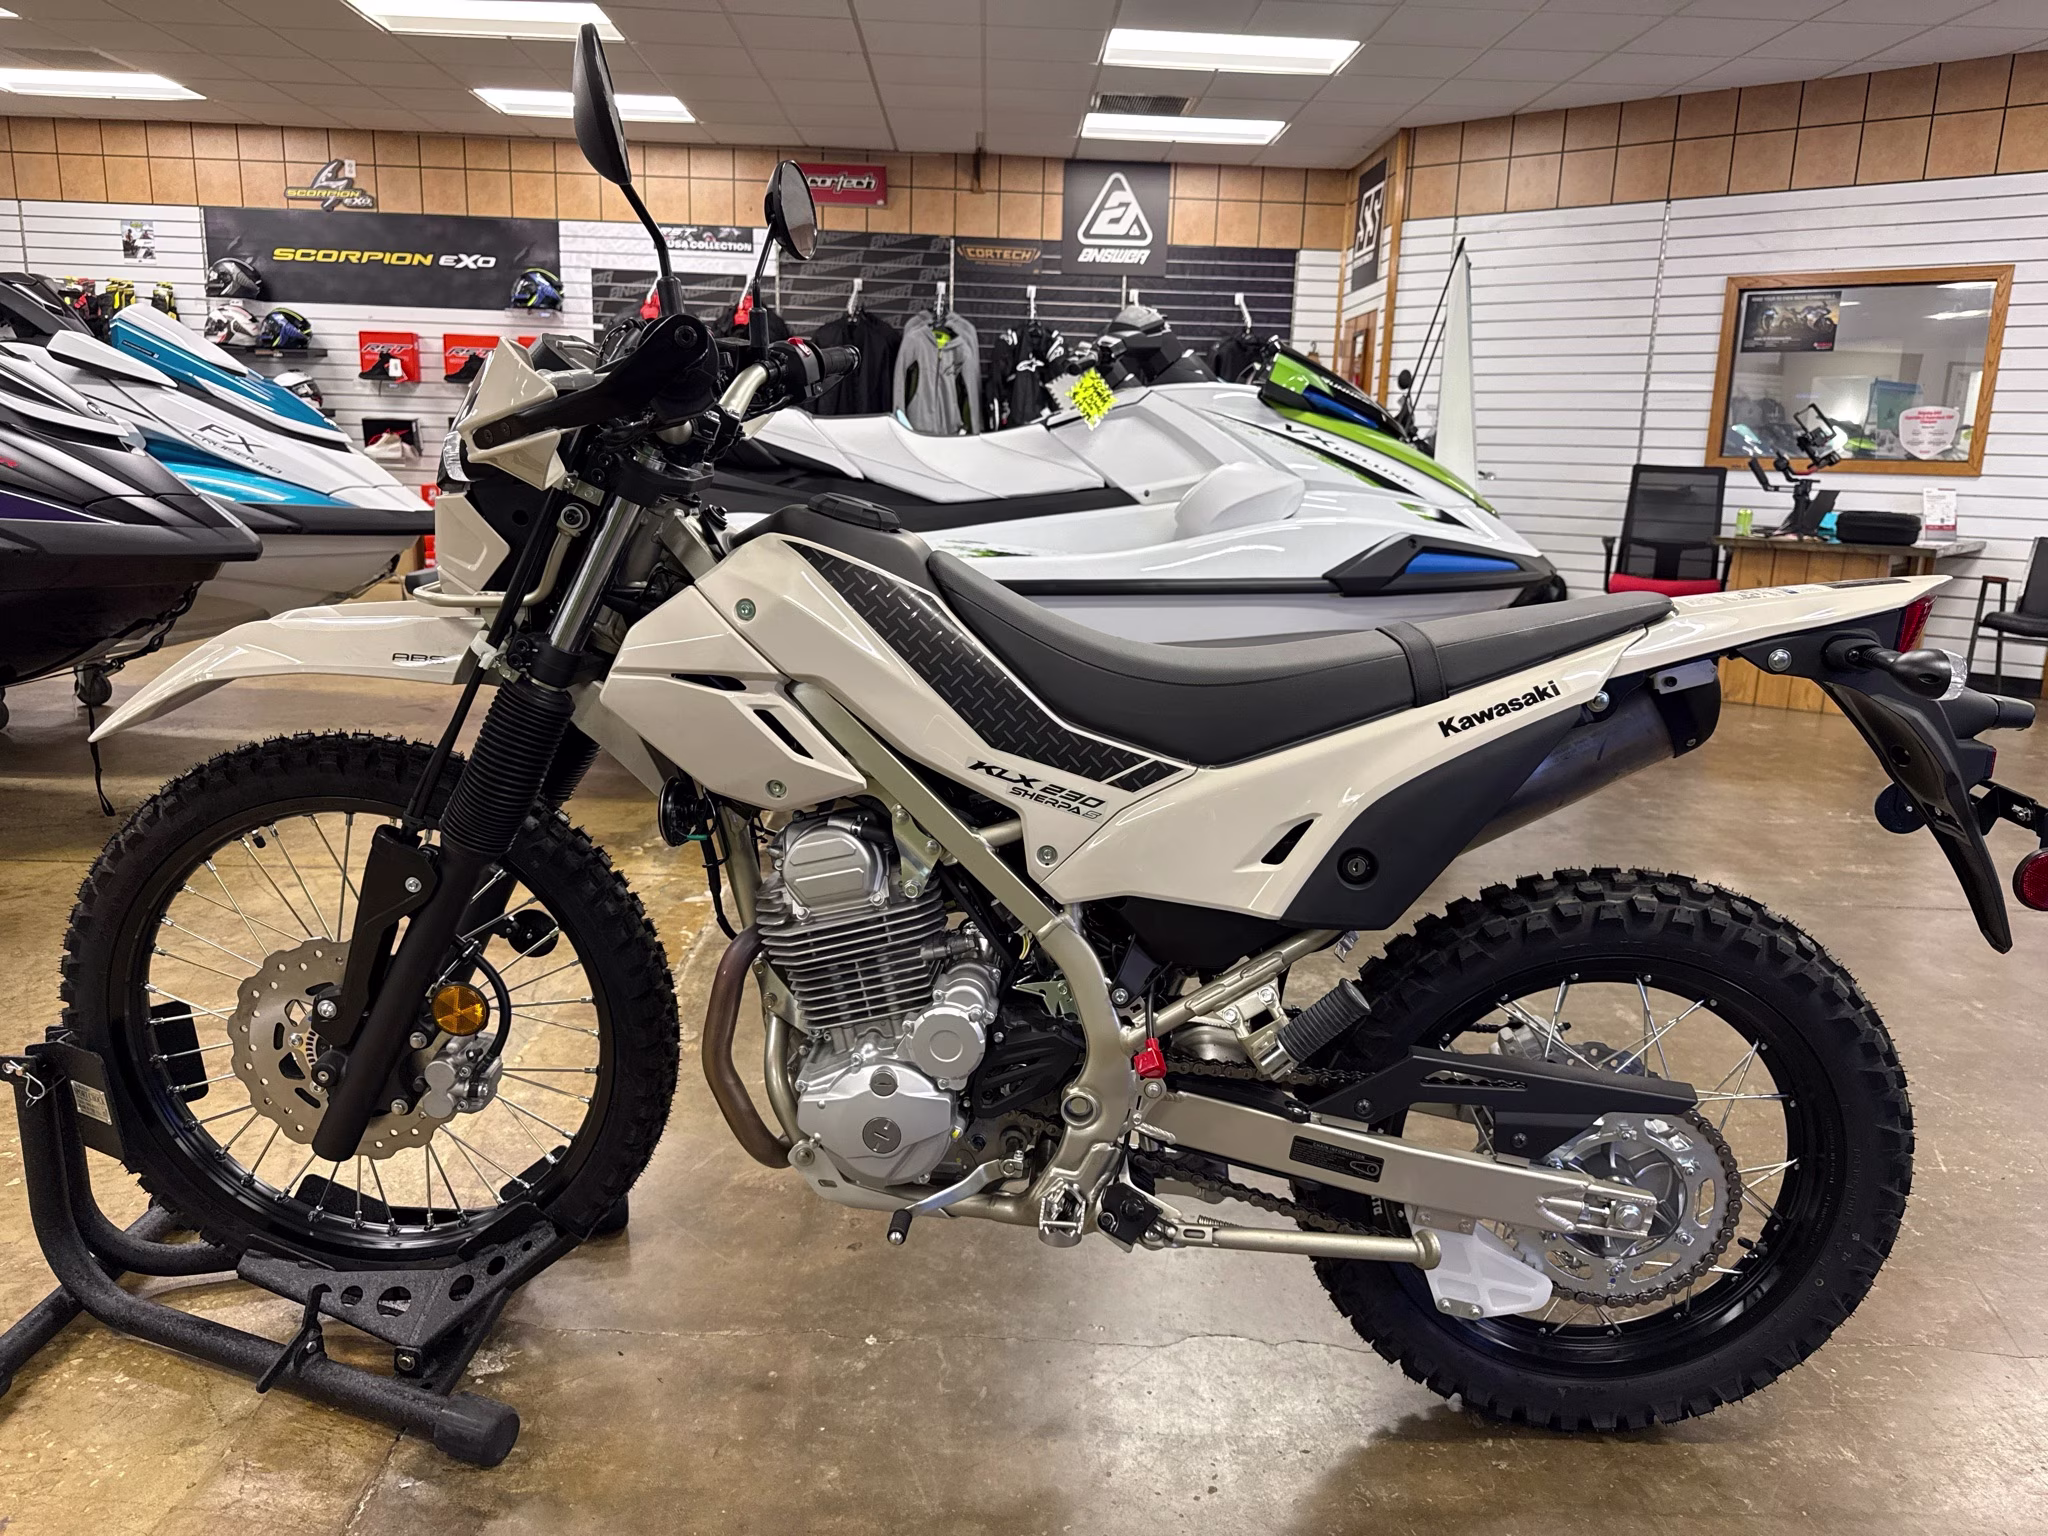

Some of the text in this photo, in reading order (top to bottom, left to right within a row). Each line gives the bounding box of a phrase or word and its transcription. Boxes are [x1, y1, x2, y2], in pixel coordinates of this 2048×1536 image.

[807, 174, 876, 192] cortech
[286, 188, 361, 198] SCORPION
[667, 240, 752, 252] USA COLLECTION
[966, 248, 1032, 261] CORTECH
[272, 248, 434, 267] SCORPION
[1077, 248, 1151, 265] ANSWER
[197, 423, 269, 455] FX
[1285, 423, 1415, 486] VX DELUXE
[392, 652, 447, 665] ABS
[1437, 680, 1561, 738] Kawasaki
[967, 760, 1107, 809] KLX 230
[1009, 786, 1081, 816] SHERPA
[1312, 1142, 1366, 1160] CHAIN INFORMATION
